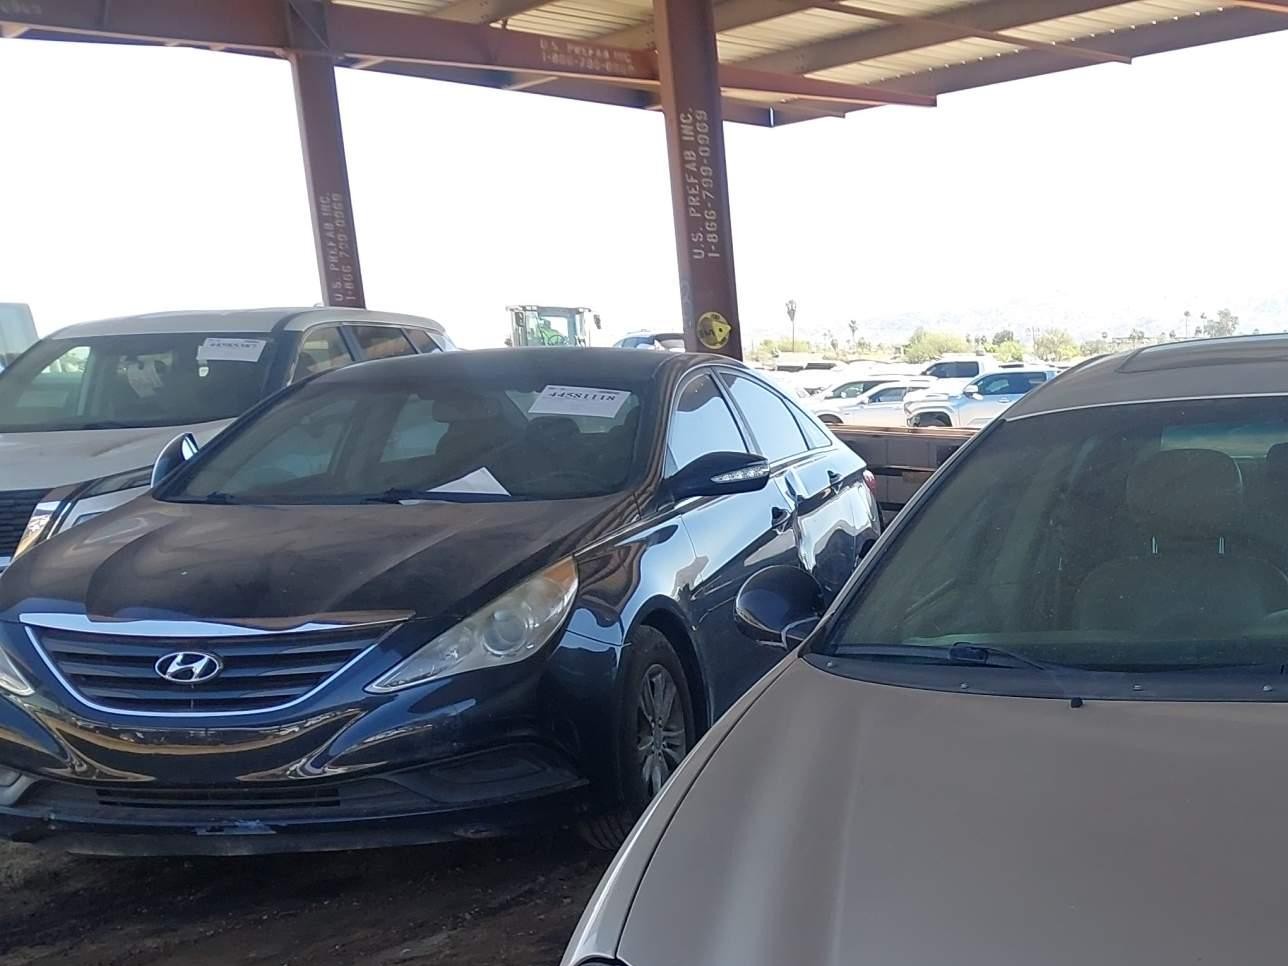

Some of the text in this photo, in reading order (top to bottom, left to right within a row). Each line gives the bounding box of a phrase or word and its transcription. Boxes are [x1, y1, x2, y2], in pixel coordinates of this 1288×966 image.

[680, 107, 705, 260] U.S. PREFAB INC.
[695, 109, 721, 258] 1-866-799-0969
